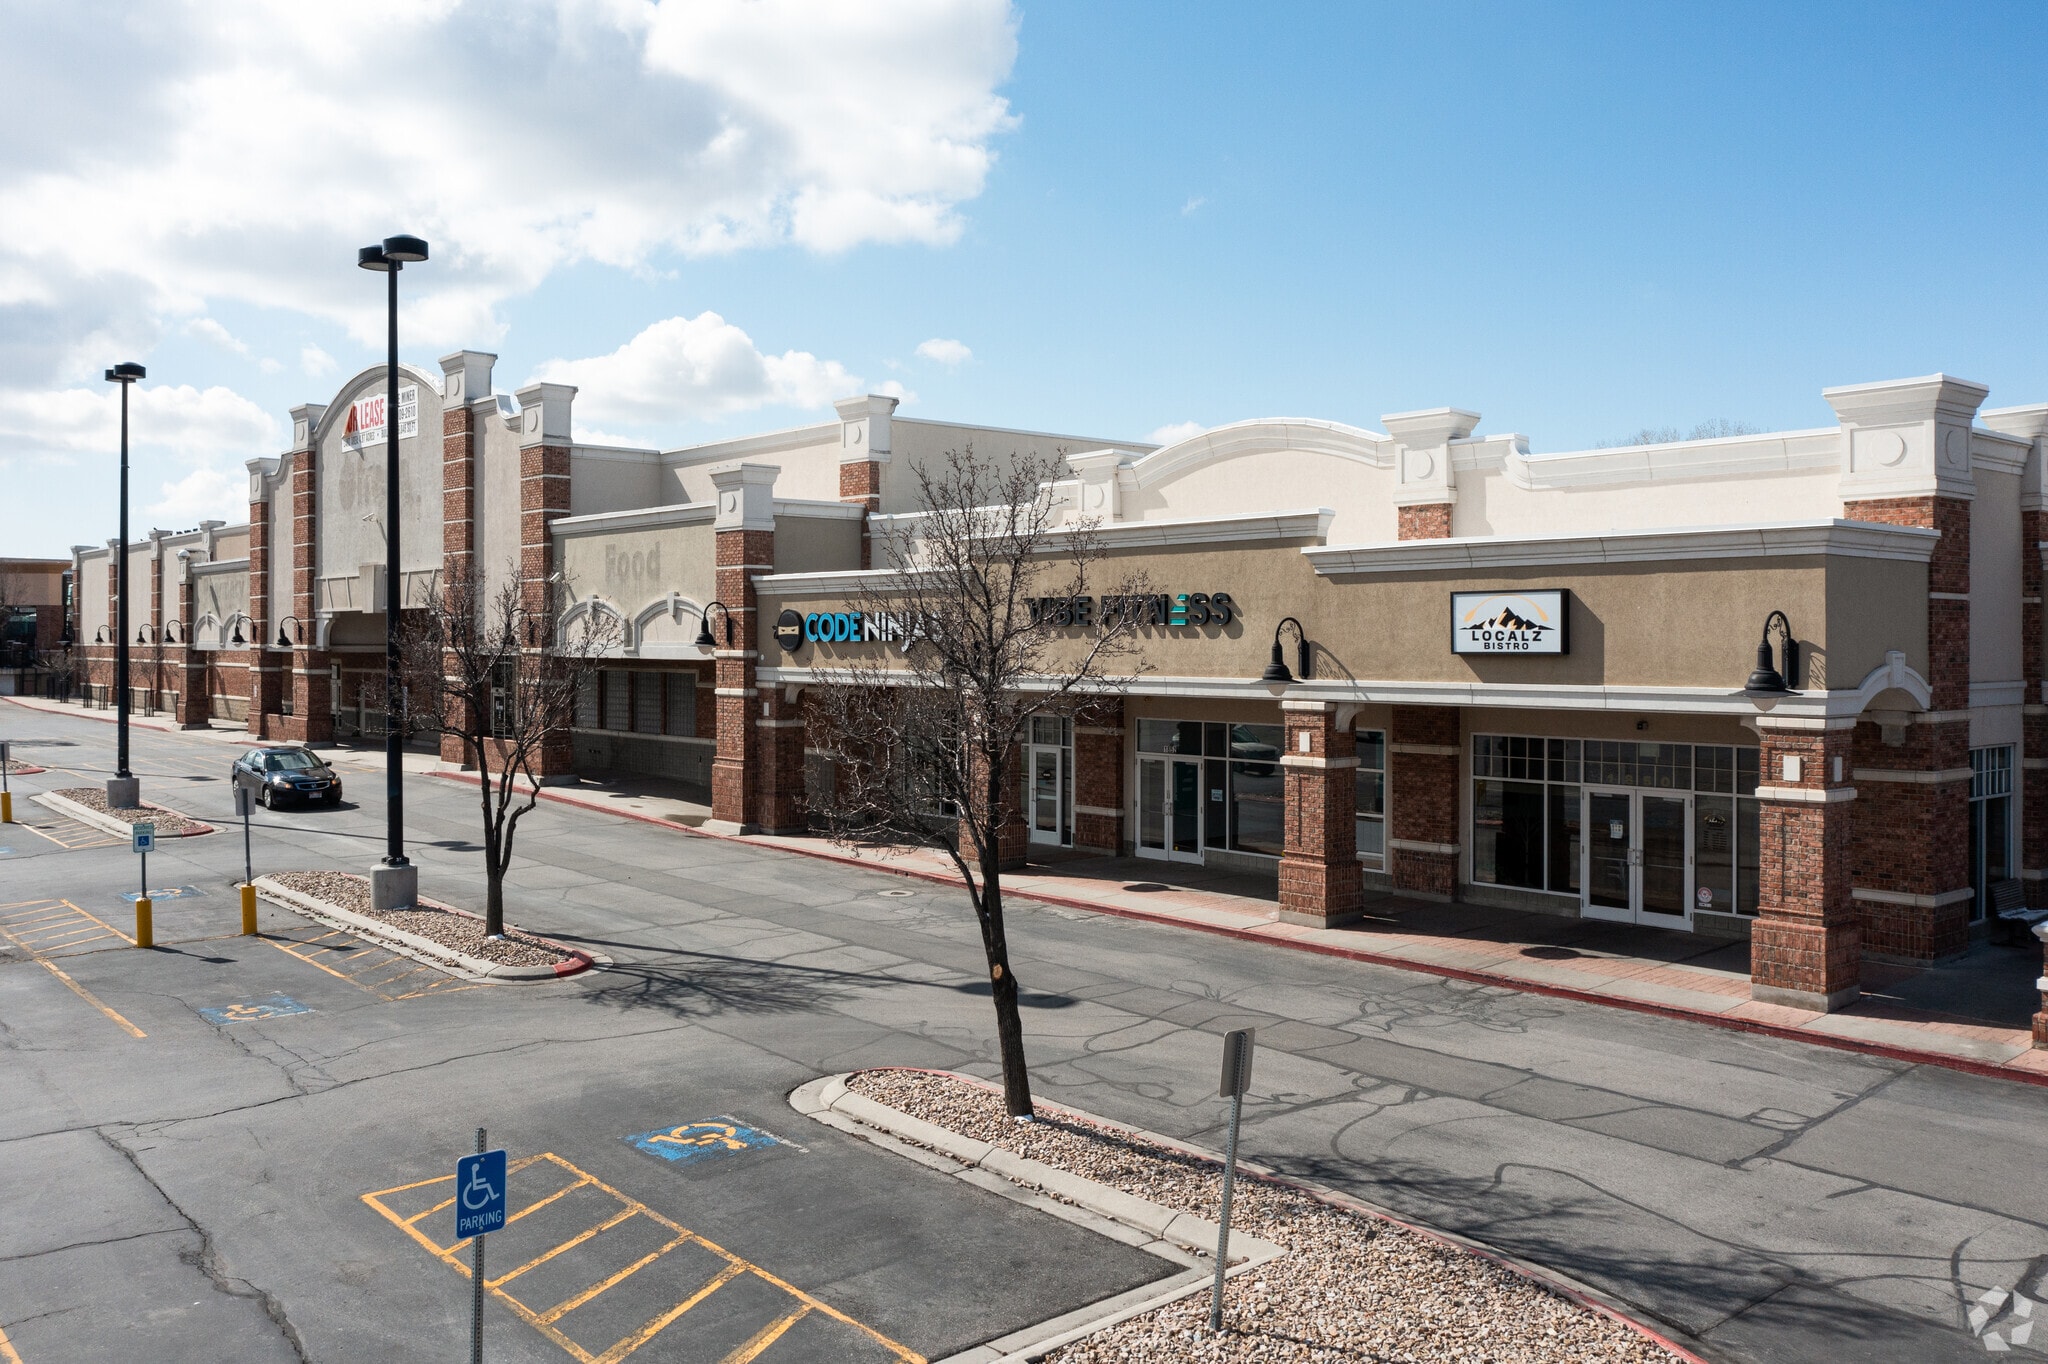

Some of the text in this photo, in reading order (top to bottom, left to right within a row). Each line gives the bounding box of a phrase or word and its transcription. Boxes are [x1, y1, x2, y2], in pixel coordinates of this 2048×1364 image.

[360, 398, 384, 430] LEASE
[605, 541, 660, 581] Food
[805, 612, 861, 642] CODE
[1471, 630, 1542, 642] LOCALZ
[1483, 642, 1529, 650] BISTRO
[460, 1209, 502, 1232] PARKING
